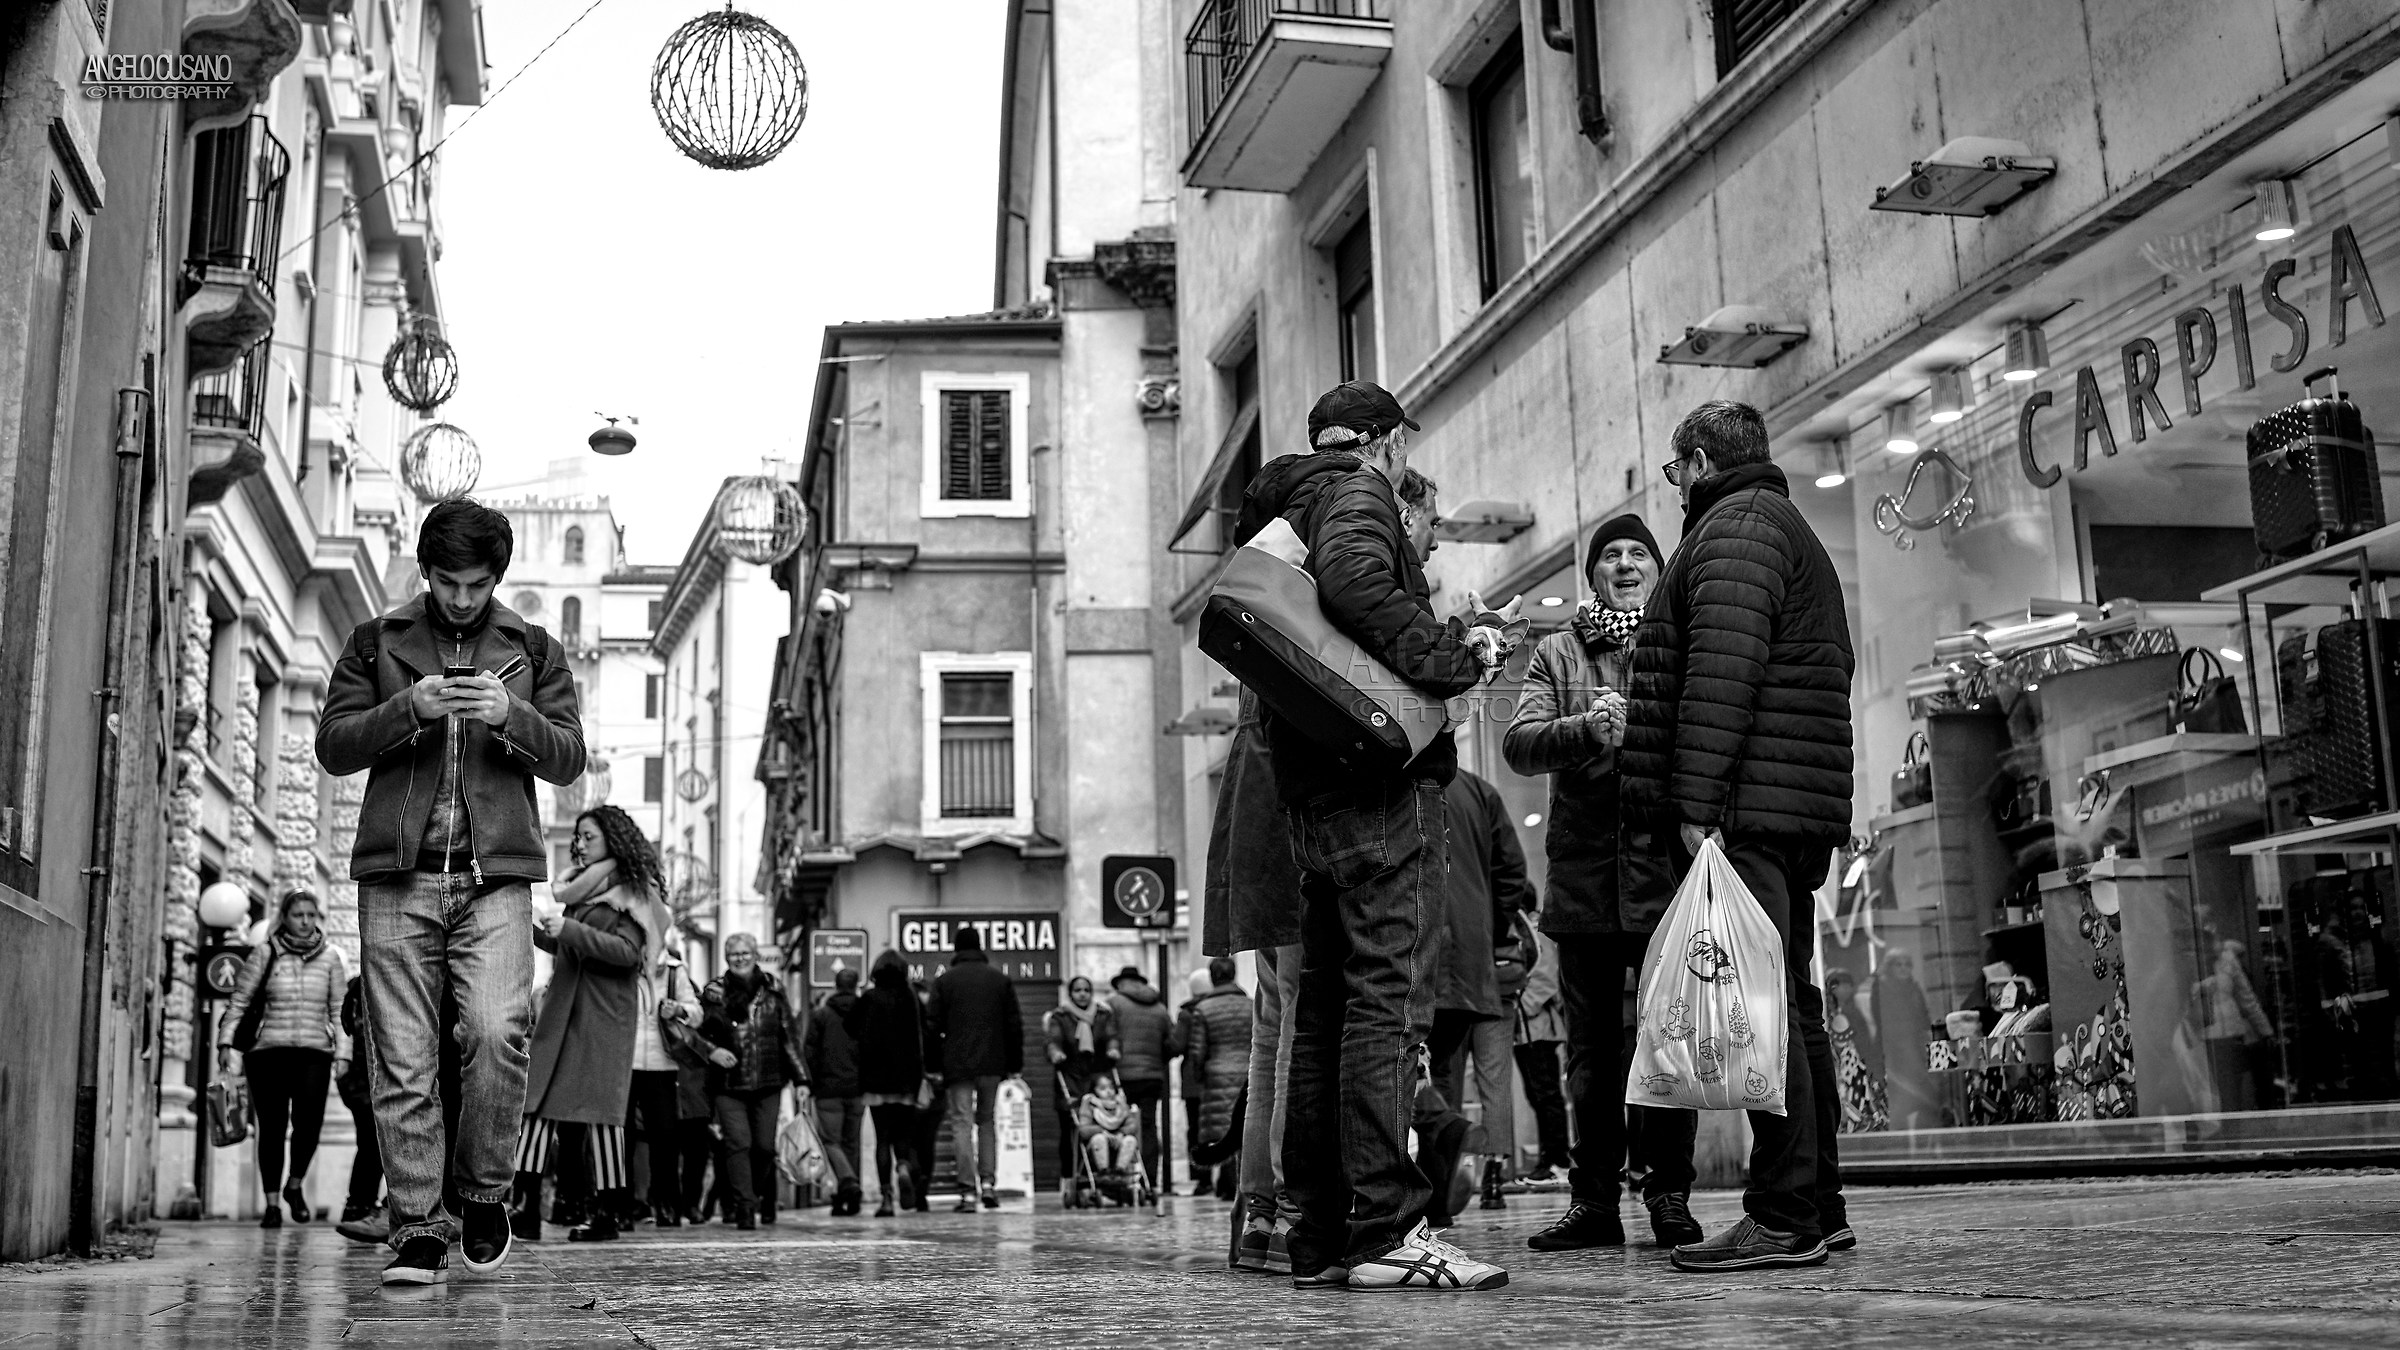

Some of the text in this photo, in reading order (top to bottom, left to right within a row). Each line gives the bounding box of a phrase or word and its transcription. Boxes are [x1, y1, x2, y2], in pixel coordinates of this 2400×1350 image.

[2018, 224, 2386, 489] CARPISA
[902, 920, 1056, 952] GELTERIA
[908, 962, 1051, 982] MAINI
